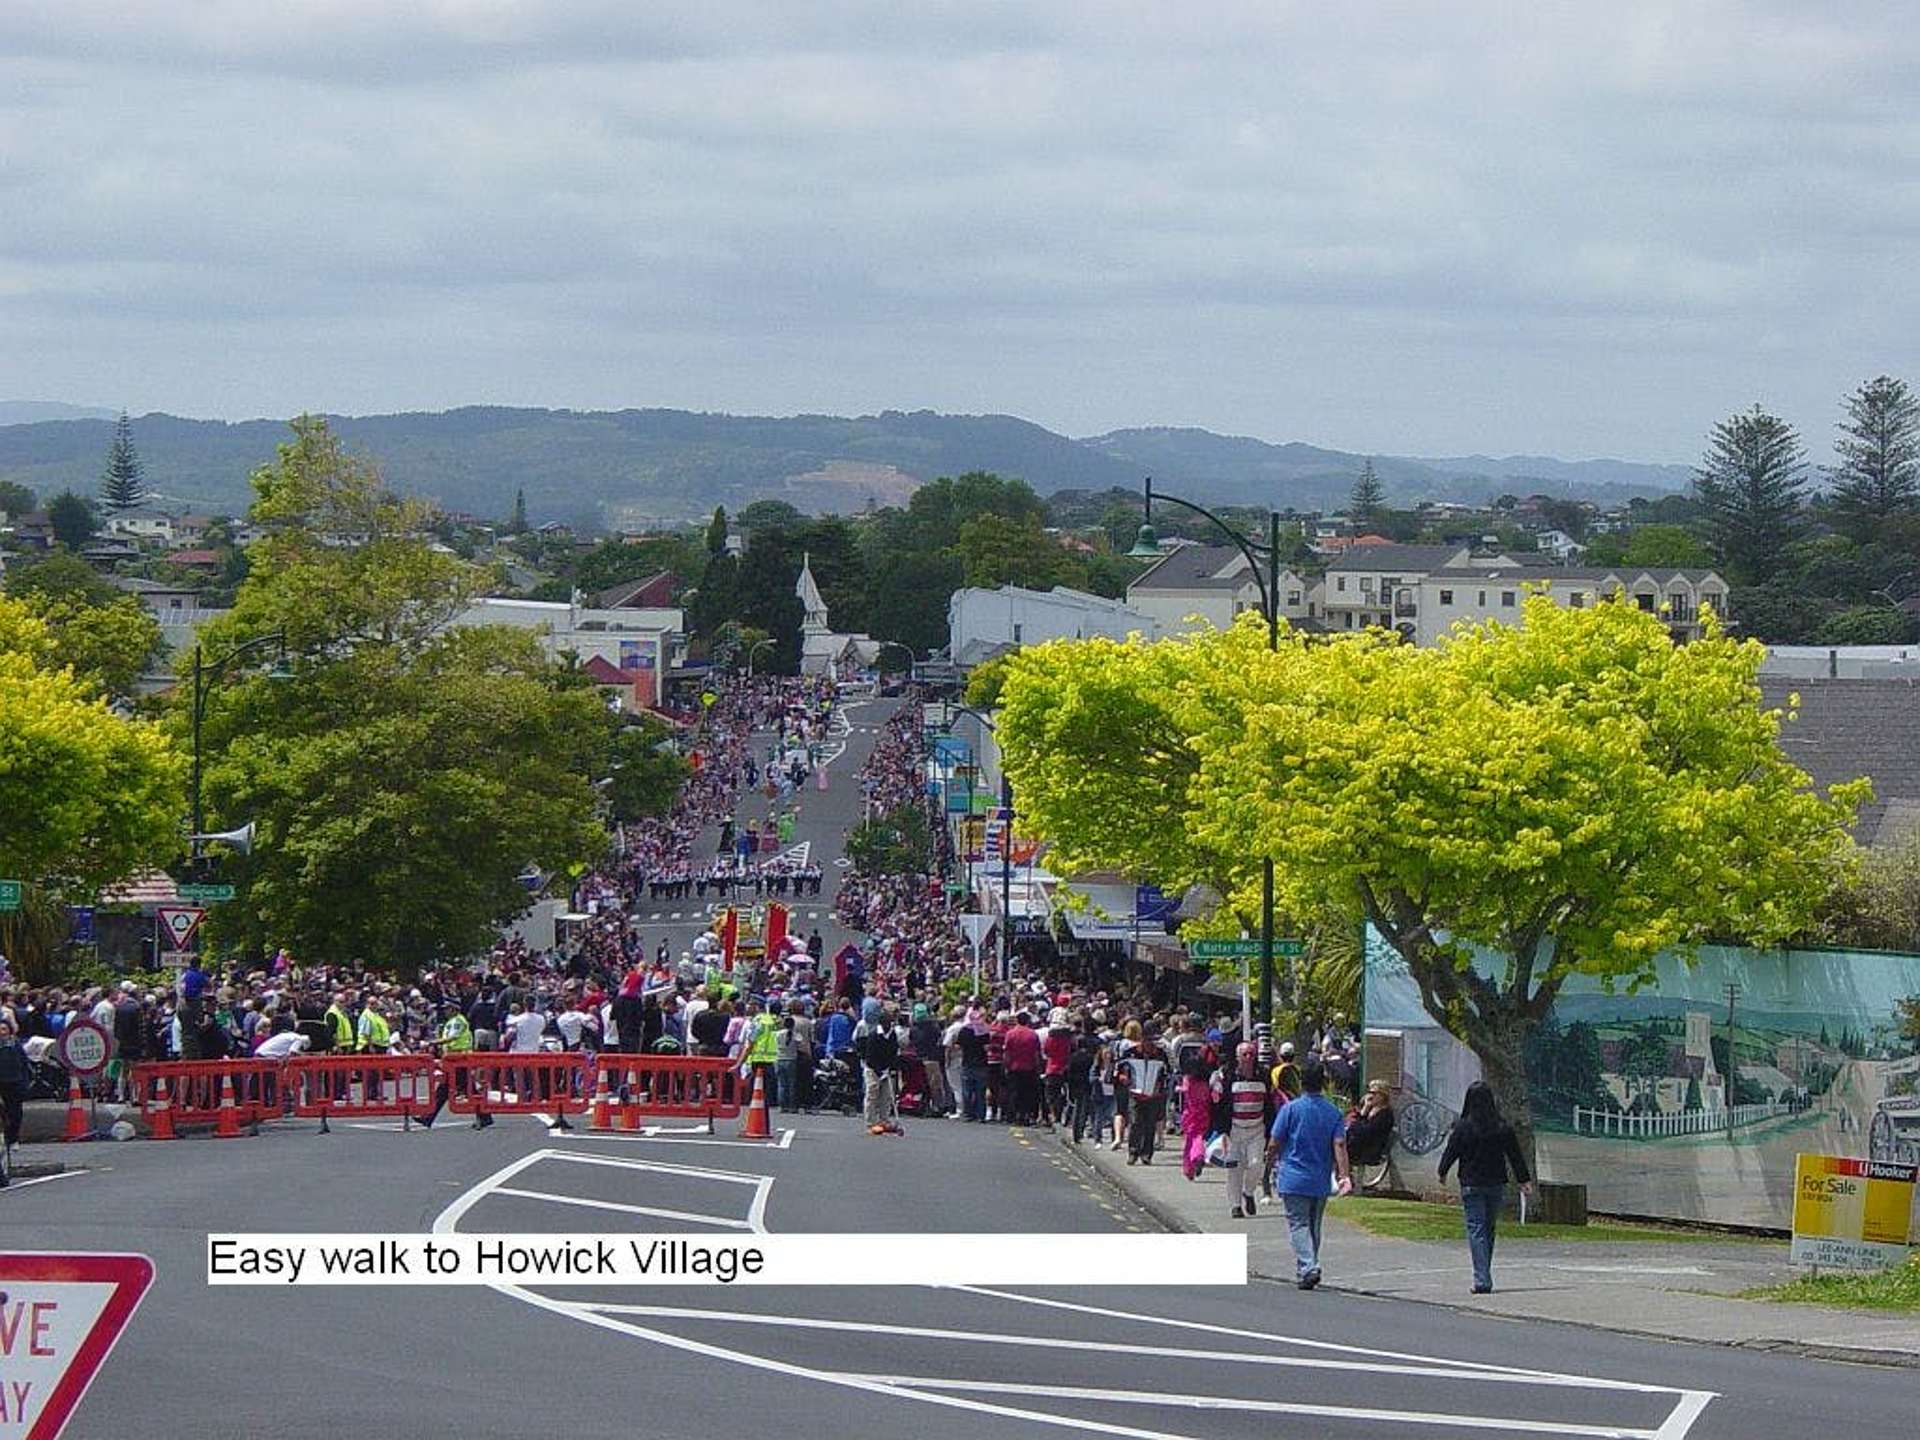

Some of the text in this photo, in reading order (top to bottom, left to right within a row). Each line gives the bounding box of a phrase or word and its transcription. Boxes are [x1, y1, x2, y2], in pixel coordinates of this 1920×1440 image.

[1290, 942, 1300, 953] St
[1870, 1165, 1912, 1179] Hooker
[1803, 1175, 1857, 1195] For Sale
